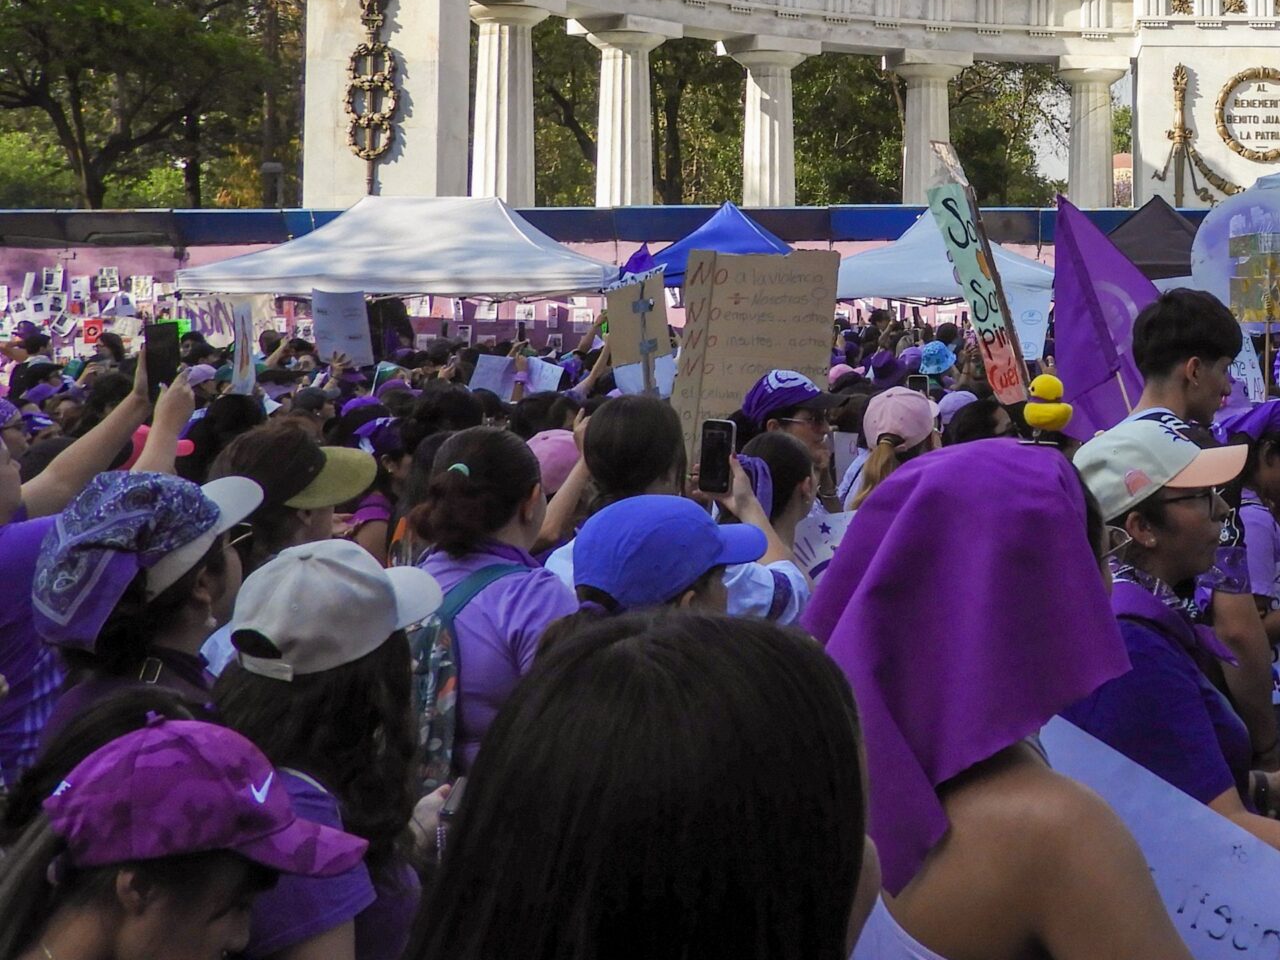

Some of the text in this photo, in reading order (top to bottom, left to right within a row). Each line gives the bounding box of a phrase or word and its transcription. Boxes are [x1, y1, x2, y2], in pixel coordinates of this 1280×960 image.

[1256, 84, 1268, 92] AL
[1226, 115, 1259, 124] BENITO
[1240, 131, 1251, 140] LA
